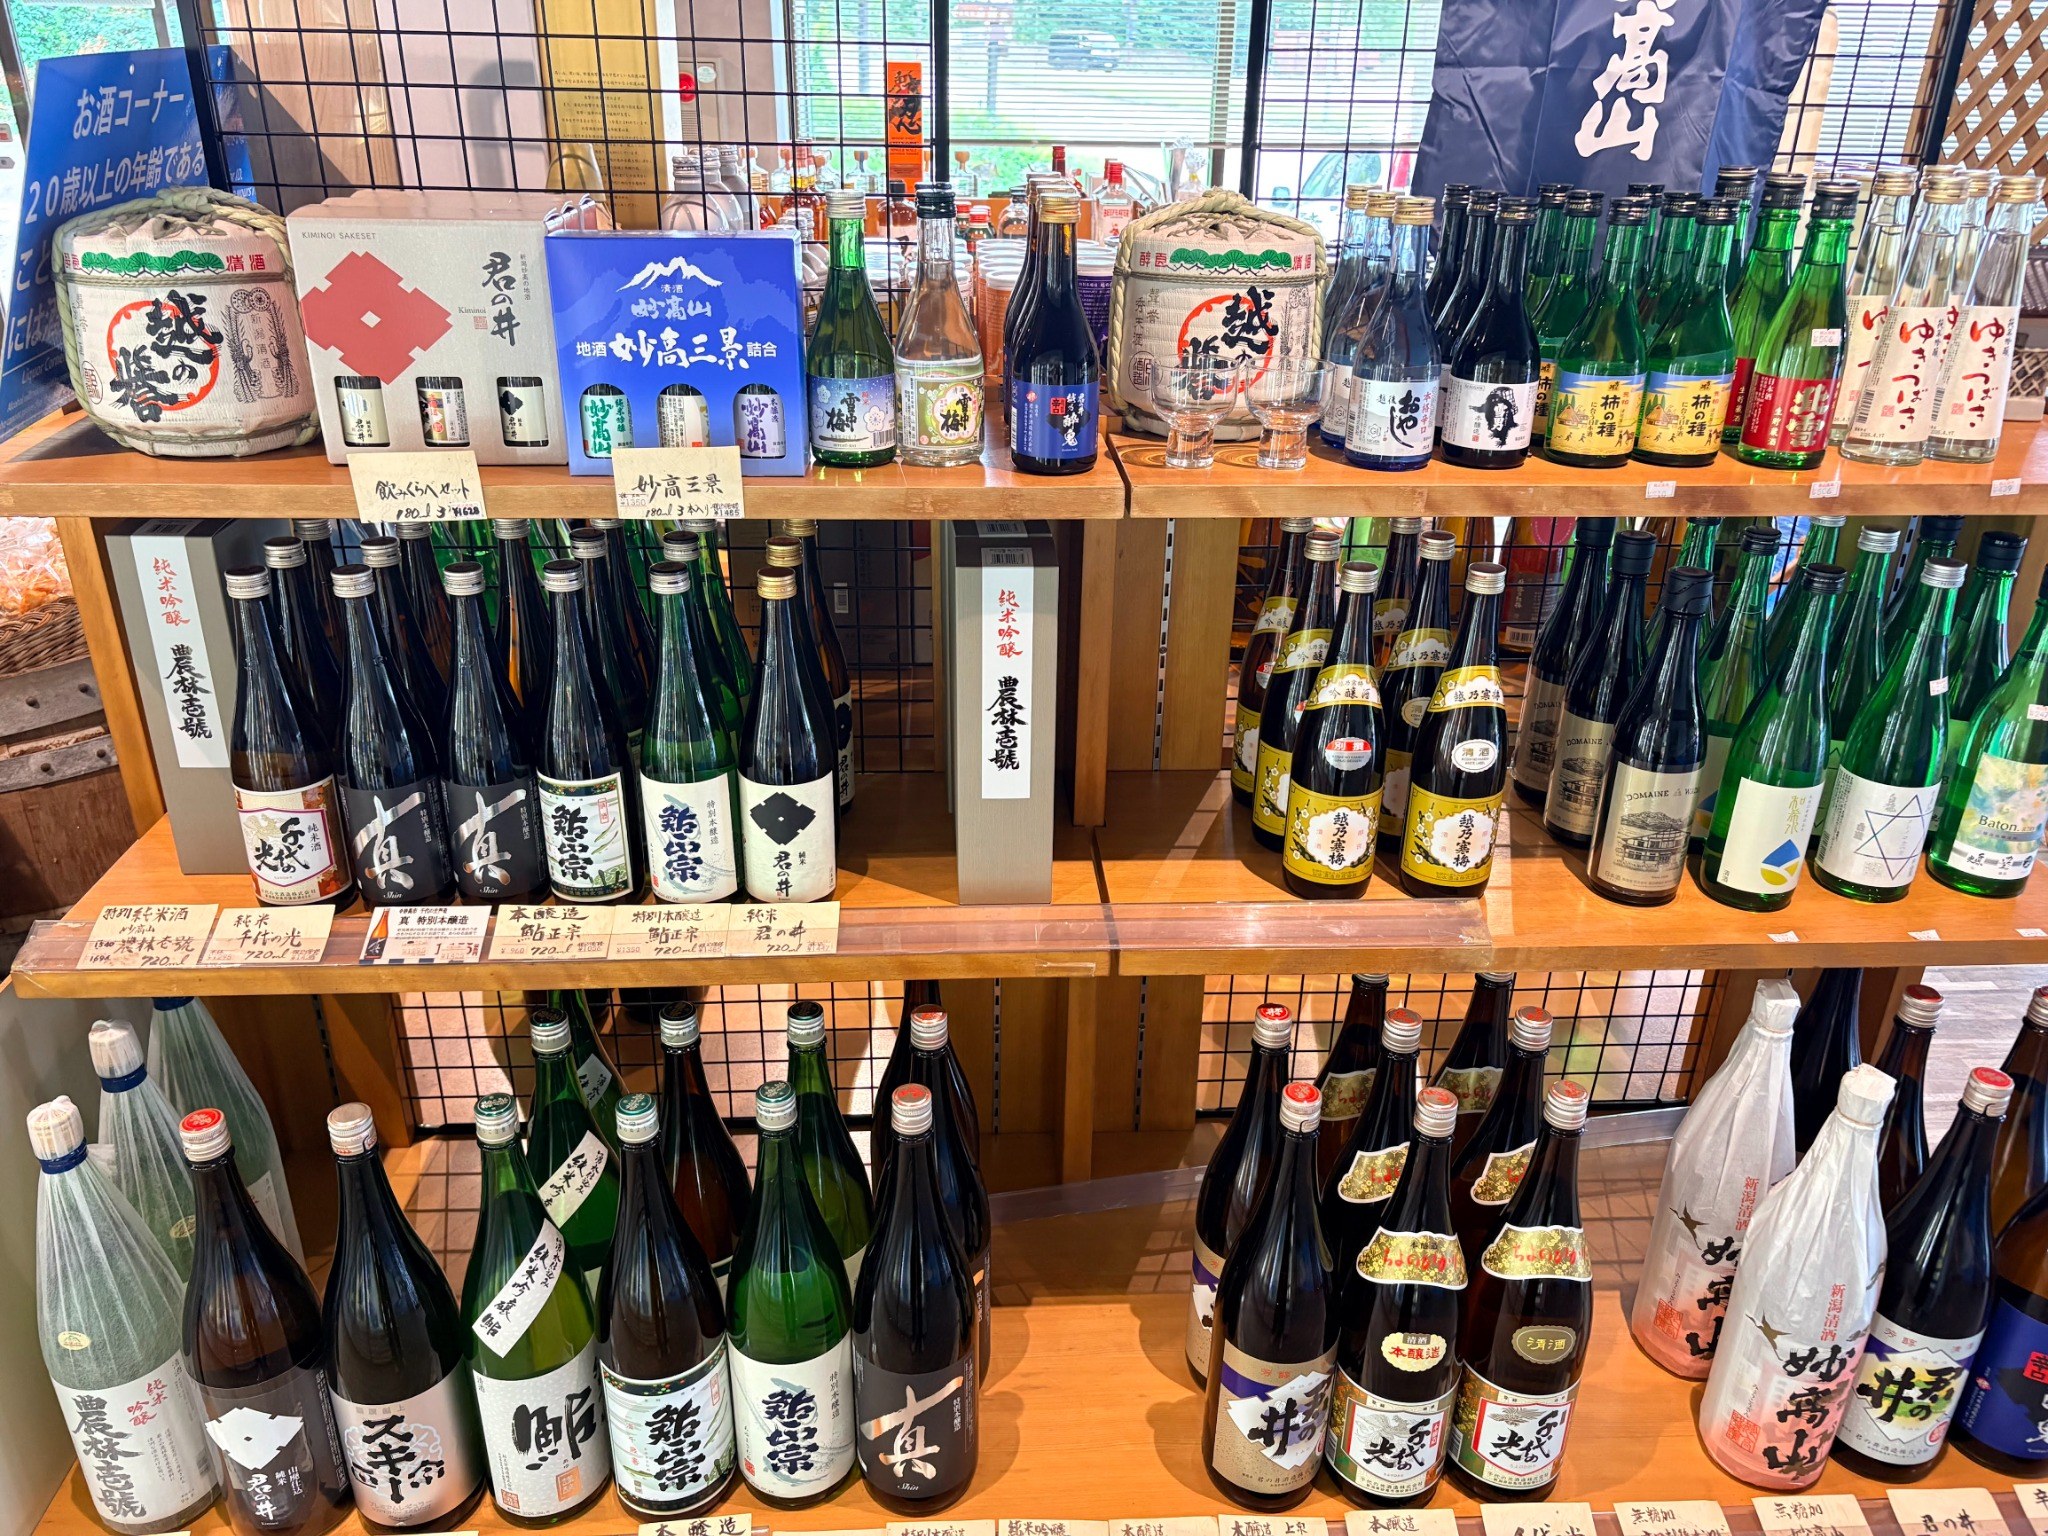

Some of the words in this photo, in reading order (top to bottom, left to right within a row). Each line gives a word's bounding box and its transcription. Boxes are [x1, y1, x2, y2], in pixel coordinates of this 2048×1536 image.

[72, 79, 185, 140] お酒コーナー
[302, 231, 336, 240] KIMINOI
[339, 232, 376, 240] SAKESET
[226, 254, 266, 272] 清酒
[482, 251, 521, 347] 君の井
[660, 283, 684, 294] 清酒
[458, 306, 487, 315] Kiminoi
[631, 295, 713, 321] 妙高山
[576, 341, 607, 357] 地酒
[608, 326, 750, 371] 妙高三景
[746, 341, 778, 357] 詰合
[1892, 317, 1935, 430] ゆきつばき
[1961, 317, 2005, 429] ゆきつばき
[1764, 378, 1776, 401] 日本酒
[825, 392, 861, 433] 雪中梅
[940, 394, 973, 433] 雪中梅
[1420, 391, 1432, 434] 本格辛口
[1596, 394, 1621, 437] 柿の種
[1685, 394, 1712, 437] 柿の種
[1767, 406, 1783, 447] 生貯蔵酒
[631, 473, 724, 503] 妙高三景
[152, 556, 191, 626] 純米吟醸
[997, 588, 1023, 659] 純米吟醸
[1461, 746, 1490, 757] 清酒
[1566, 738, 1603, 747] DOMAINE
[1626, 789, 1669, 802] DOMAINE
[706, 799, 719, 845] 特別本醸造
[307, 823, 322, 852] 純米酒
[353, 795, 426, 890] 真
[452, 790, 527, 886] 真
[551, 804, 593, 881] 鮎正宗
[658, 804, 704, 883] 鮎正宗
[1328, 811, 1349, 866] 越乃寒梅
[1452, 814, 1475, 868] 越乃寒梅
[798, 851, 807, 865] 純米
[772, 850, 794, 898] 君の井
[383, 890, 403, 899] Shin
[480, 885, 499, 895] Shin
[102, 907, 189, 923] 特別純米酒
[233, 913, 270, 928] 純米
[399, 915, 410, 926] 真
[417, 915, 470, 926] 特別本醸造
[509, 906, 590, 923] 本醸造
[631, 908, 704, 924] 特別本醸造
[743, 908, 778, 924] 純米
[237, 927, 303, 949] 千代の光
[517, 922, 582, 943] 鮎正宗
[644, 925, 699, 945] 鮎正宗
[753, 919, 807, 944] 君の井
[140, 954, 190, 967] 720ml
[245, 948, 290, 961] 720ml
[530, 943, 574, 956] 720ml
[654, 943, 698, 957] 720ml
[766, 943, 803, 954] 720ml
[1735, 1176, 1760, 1232] 新潟清酒
[1820, 1282, 1846, 1342] 新潟清酒
[1388, 1346, 1441, 1360] 本醸造
[1406, 1335, 1428, 1345] 清酒
[1526, 1336, 1567, 1352] 清酒
[146, 1378, 169, 1407] 純米
[829, 1370, 841, 1420] 特別本醸造
[1760, 1343, 1857, 1471] 妙高山
[1856, 1366, 1964, 1424] 君の井
[127, 1400, 158, 1427] 吟醸
[511, 1385, 597, 1471] 鮎
[860, 1375, 964, 1481] 真
[645, 1398, 706, 1492] 鮎正宗
[761, 1389, 820, 1476] 鮎正宗
[1363, 1418, 1431, 1471] 千代の光
[1487, 1408, 1560, 1463] 千代の光
[361, 1414, 417, 1504] スキー
[275, 1470, 288, 1486] 純米
[897, 1482, 920, 1492] Shin
[246, 1473, 278, 1521] 君の井
[1368, 1514, 1420, 1534] 本醸造
[1922, 1508, 1976, 1535] 君の井
